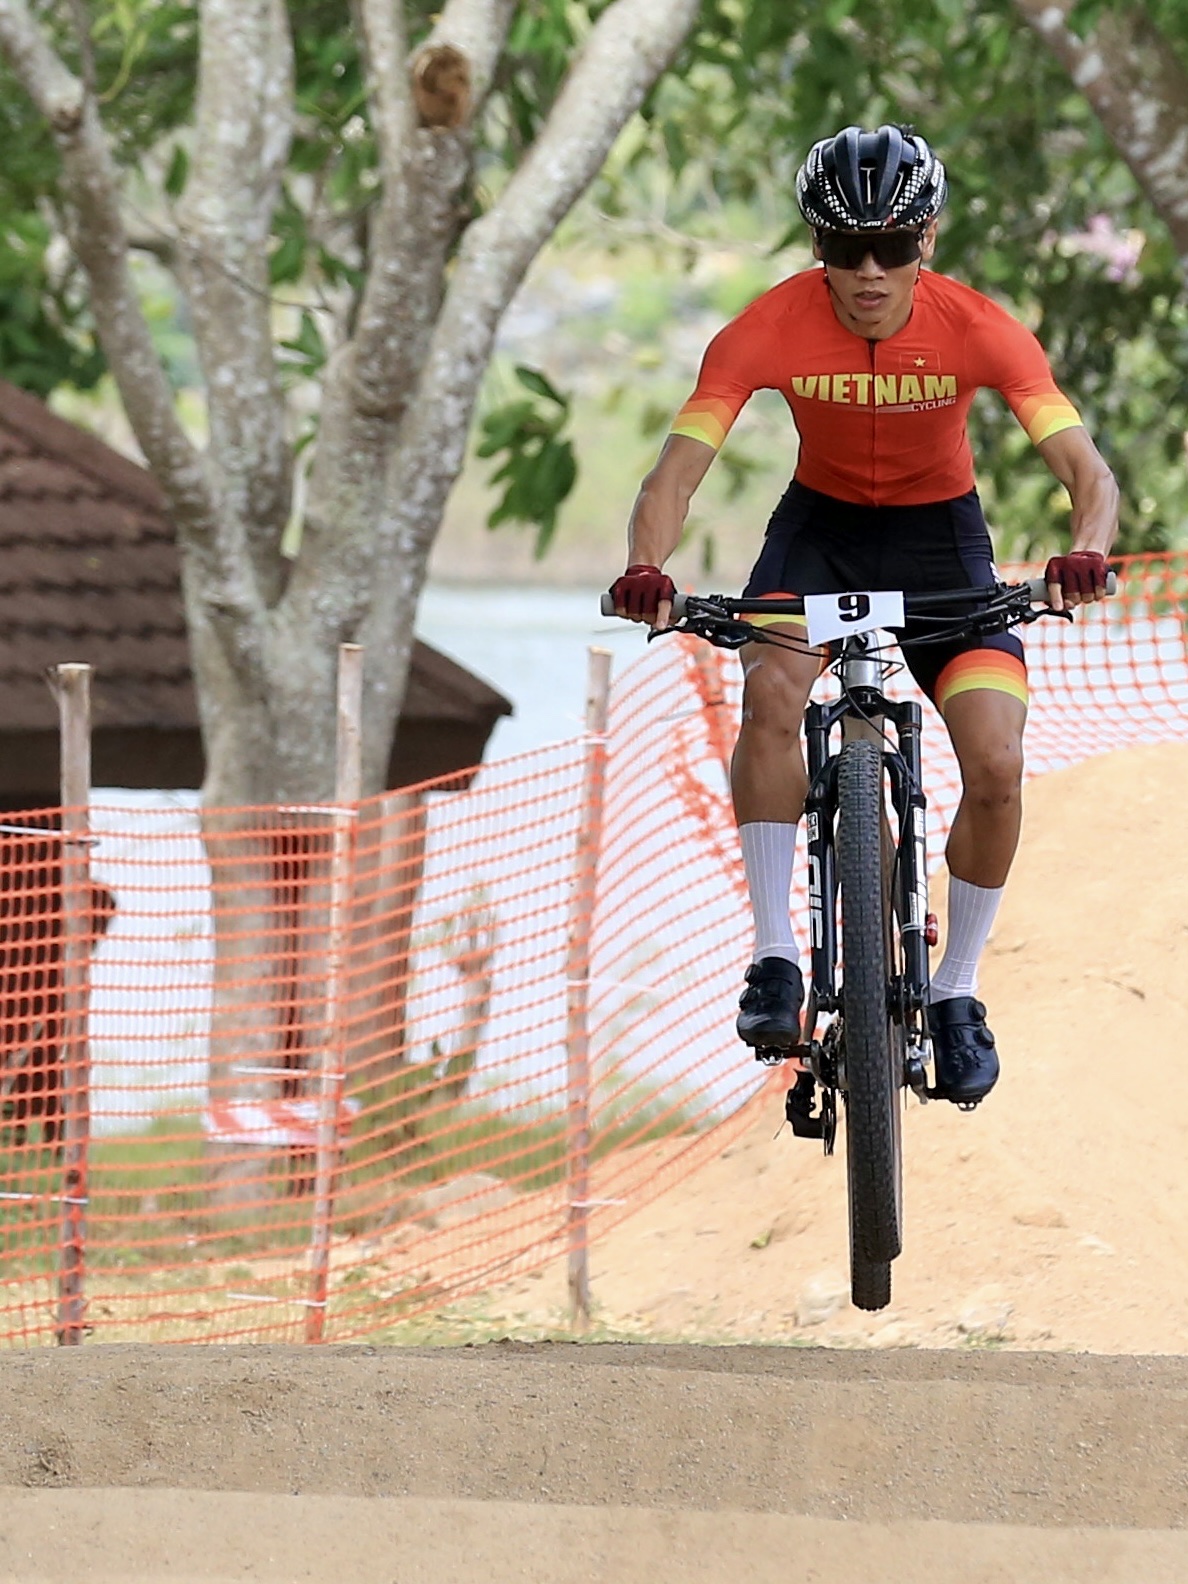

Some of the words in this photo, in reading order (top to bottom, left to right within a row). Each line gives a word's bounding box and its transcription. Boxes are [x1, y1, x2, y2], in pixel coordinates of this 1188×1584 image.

[791, 373, 957, 406] VIETNAM
[911, 397, 957, 412] CYCLING
[838, 594, 870, 622] 9
